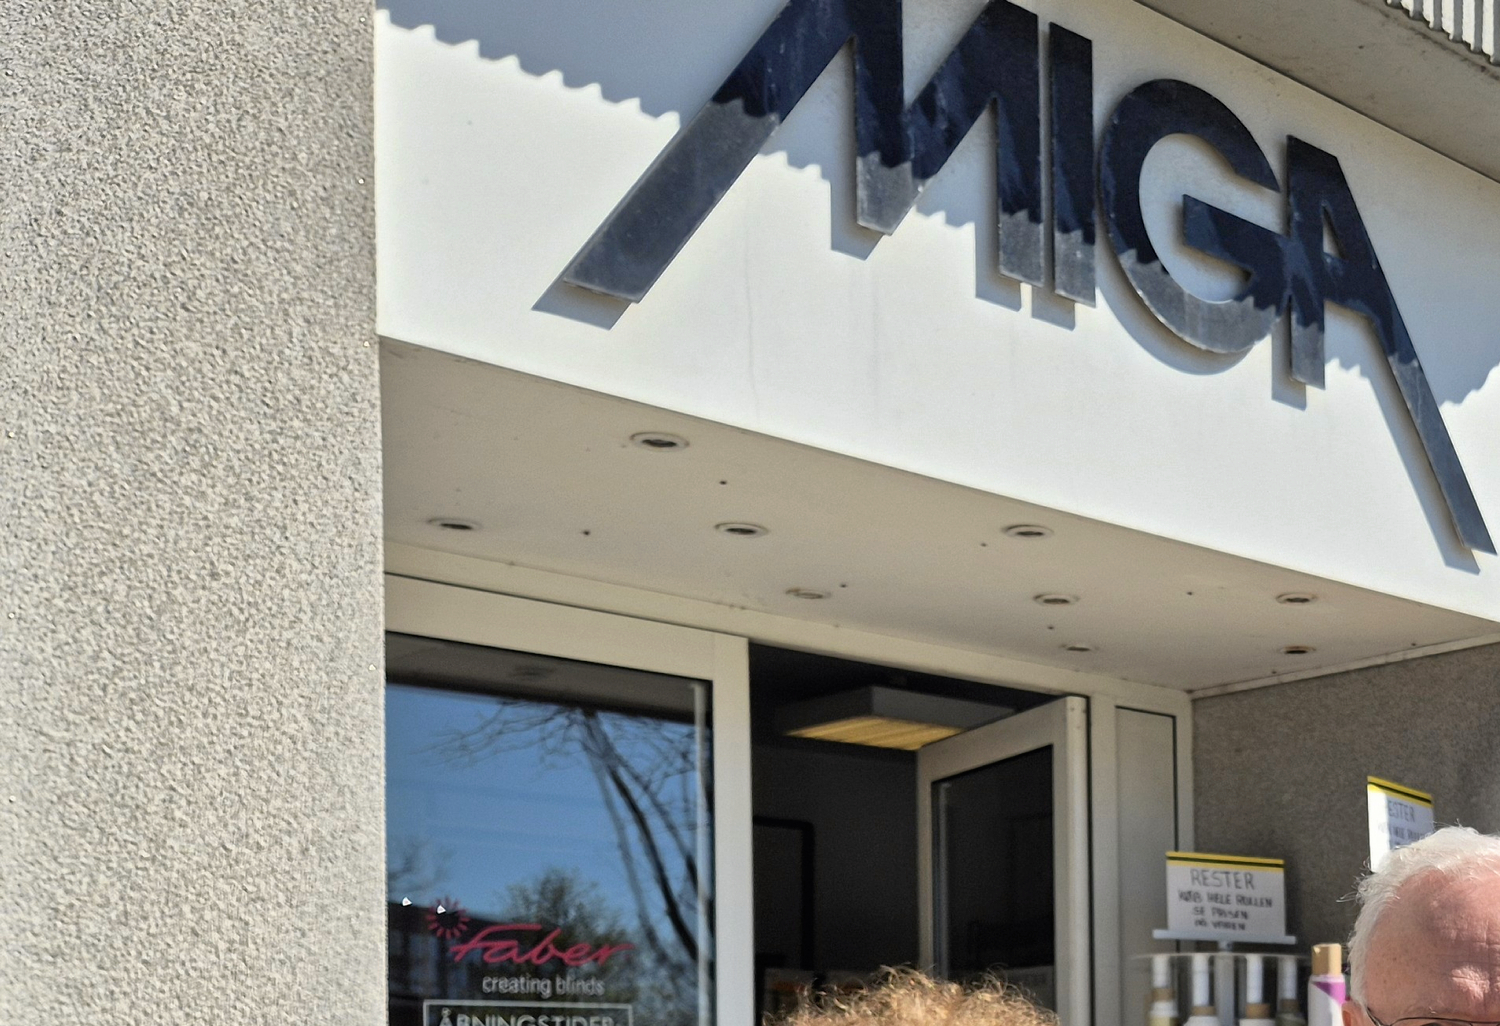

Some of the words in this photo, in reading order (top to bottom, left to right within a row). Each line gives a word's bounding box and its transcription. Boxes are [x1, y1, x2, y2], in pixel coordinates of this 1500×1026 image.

[564, 0, 1498, 557] MIGA
[1388, 800, 1416, 823] ESTER
[1190, 868, 1255, 890] RESTER
[449, 923, 636, 967] Faber
[482, 973, 552, 999] creating
[555, 973, 606, 997] blinds
